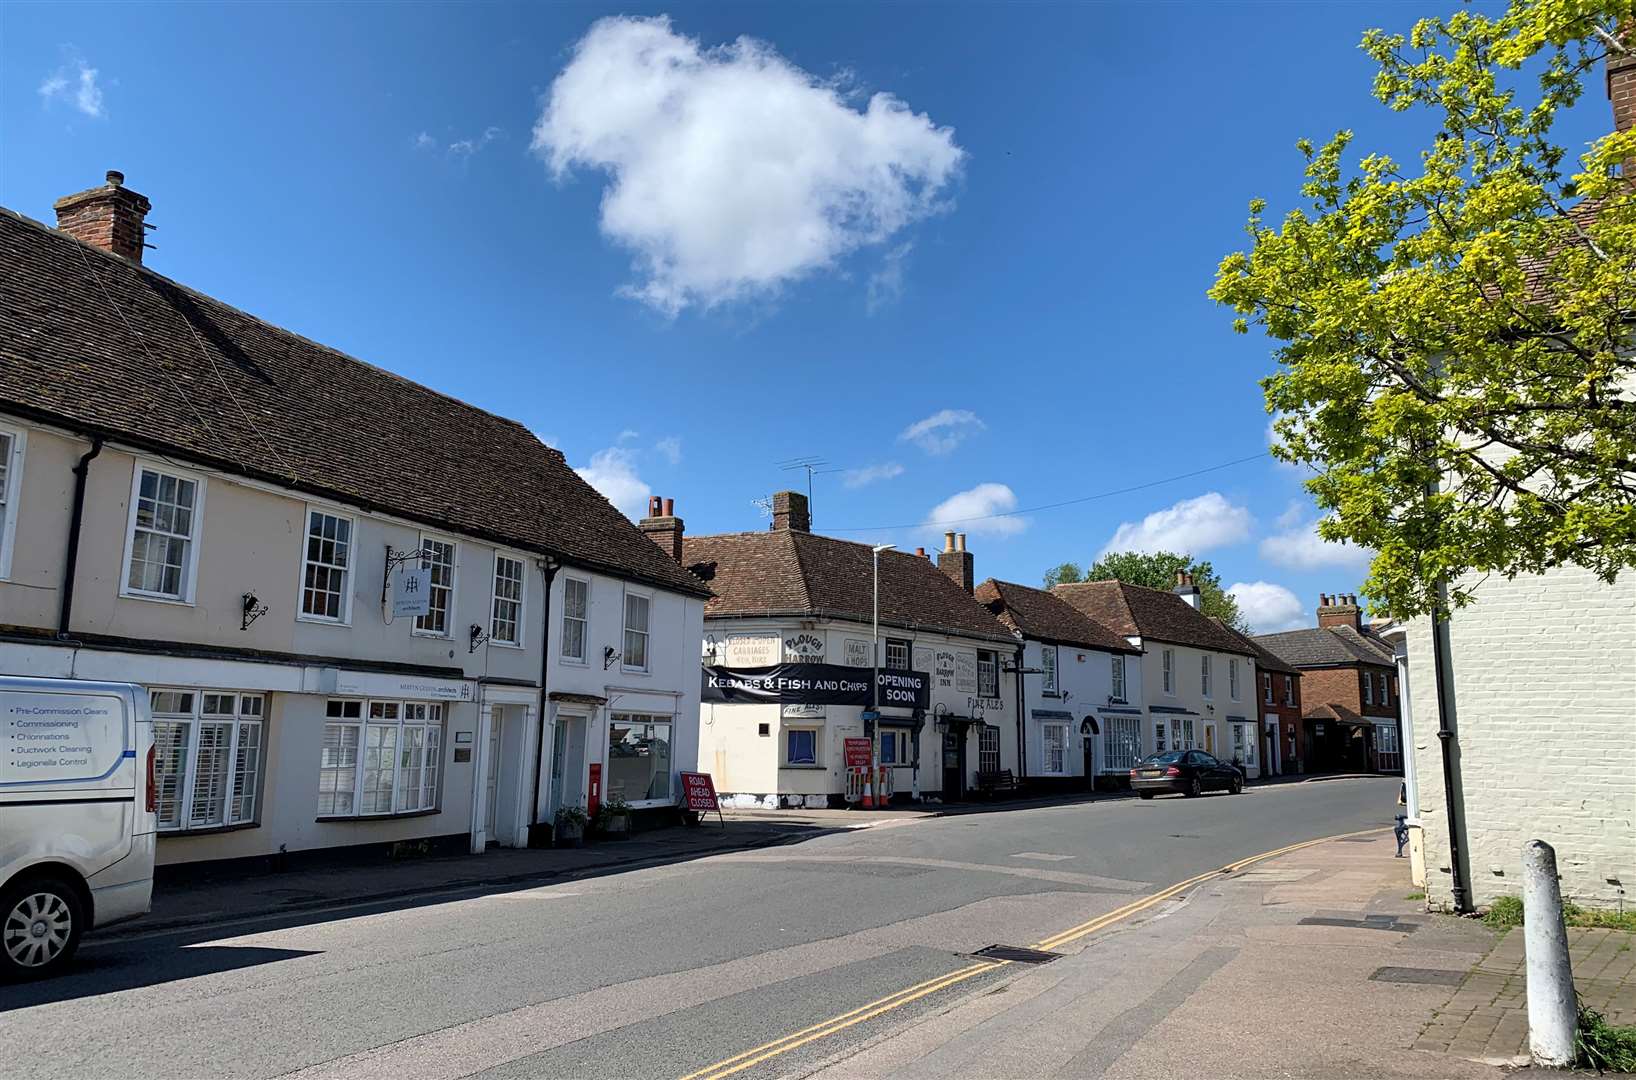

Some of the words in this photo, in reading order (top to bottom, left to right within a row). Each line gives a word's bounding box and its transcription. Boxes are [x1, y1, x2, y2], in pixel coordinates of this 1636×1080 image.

[785, 634, 823, 651] PLOUGH
[848, 644, 865, 654] MALT
[785, 654, 825, 664] HARROW
[763, 678, 774, 689] &
[814, 680, 838, 691] AND
[877, 674, 921, 689] OPENING
[886, 689, 915, 702] SOON
[967, 697, 984, 709] FINE
[985, 699, 1004, 710] ALES
[15, 707, 81, 715] Pre-Commission
[83, 708, 108, 716] Cleans
[16, 720, 79, 729] Commissioning
[17, 746, 57, 754] Ductwork
[59, 746, 92, 754] Cleaning
[17, 760, 57, 768] Legionella
[59, 758, 88, 766] Control
[688, 776, 706, 786] ROAD
[690, 787, 710, 797] AHEAD
[690, 798, 715, 808] CLOSED
